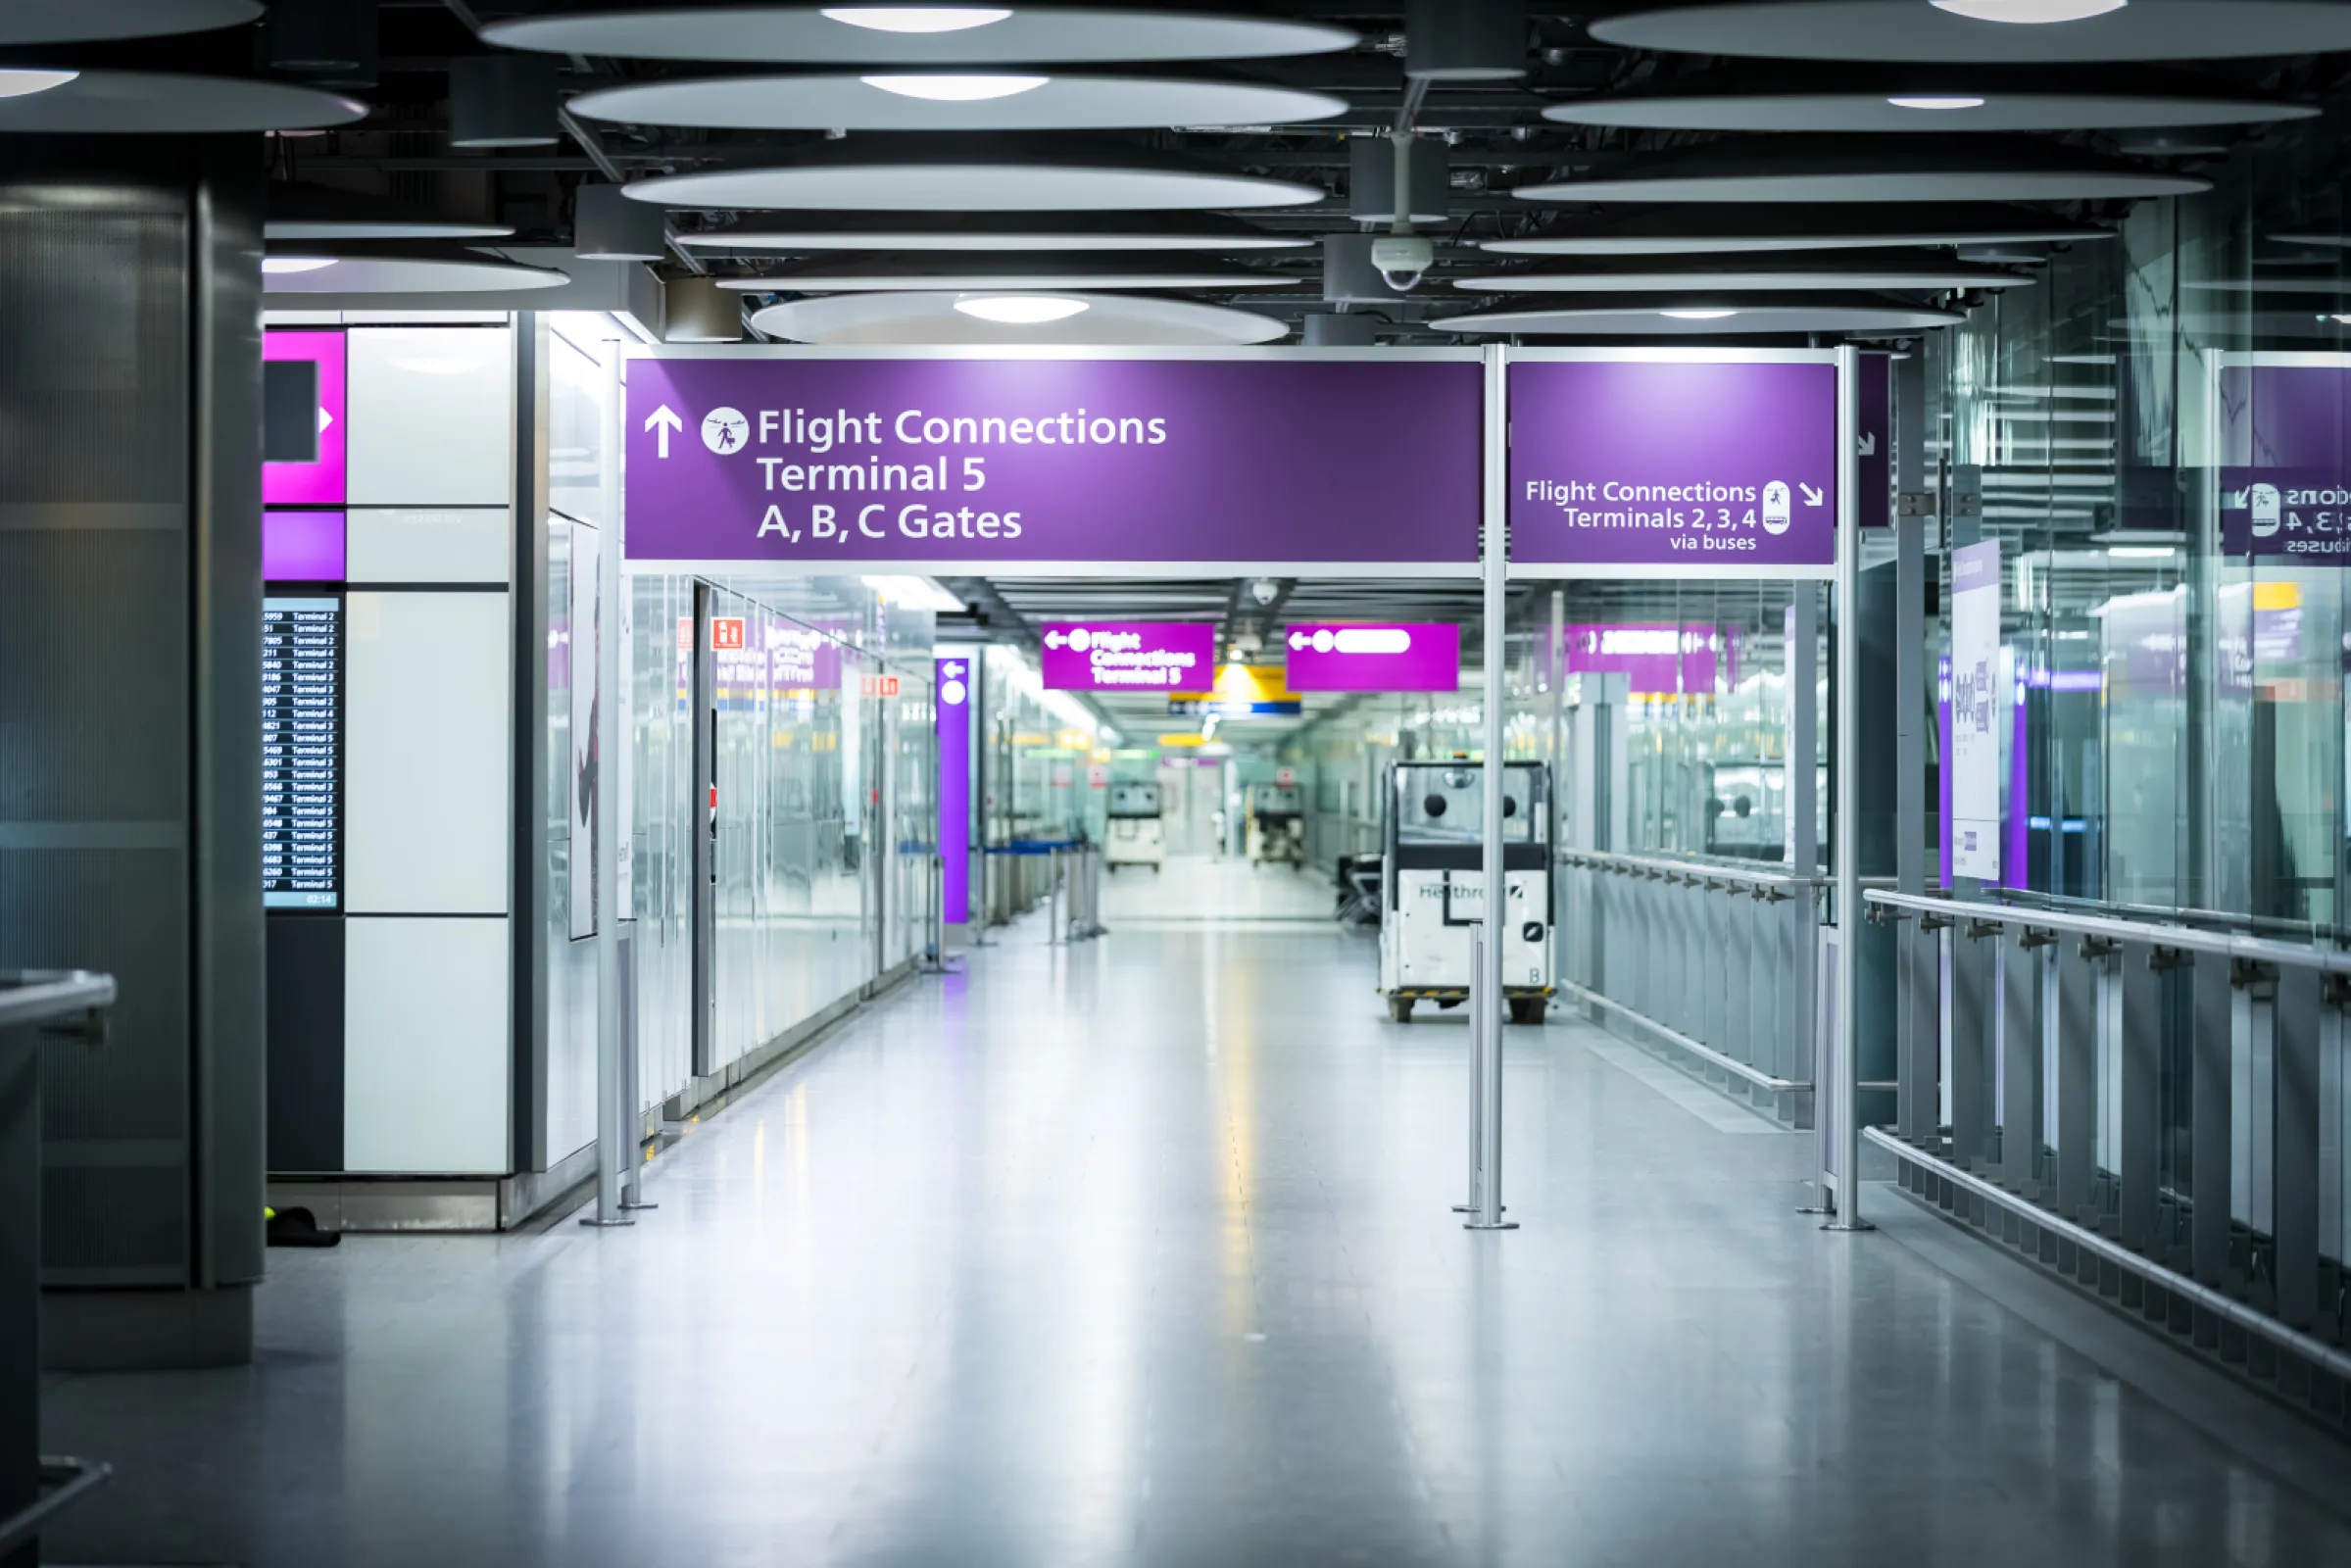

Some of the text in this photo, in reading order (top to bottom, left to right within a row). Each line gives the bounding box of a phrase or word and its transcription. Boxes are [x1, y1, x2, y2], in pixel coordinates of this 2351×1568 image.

[757, 409, 1166, 453] Flight Connections
[757, 455, 986, 491] Terminal 5
[1527, 480, 1756, 507] Flight Connections
[757, 505, 1022, 544] A, B, C Gates
[1563, 508, 1757, 532] Terminals 2, 3, 4
[1670, 534, 1757, 551] via buses
